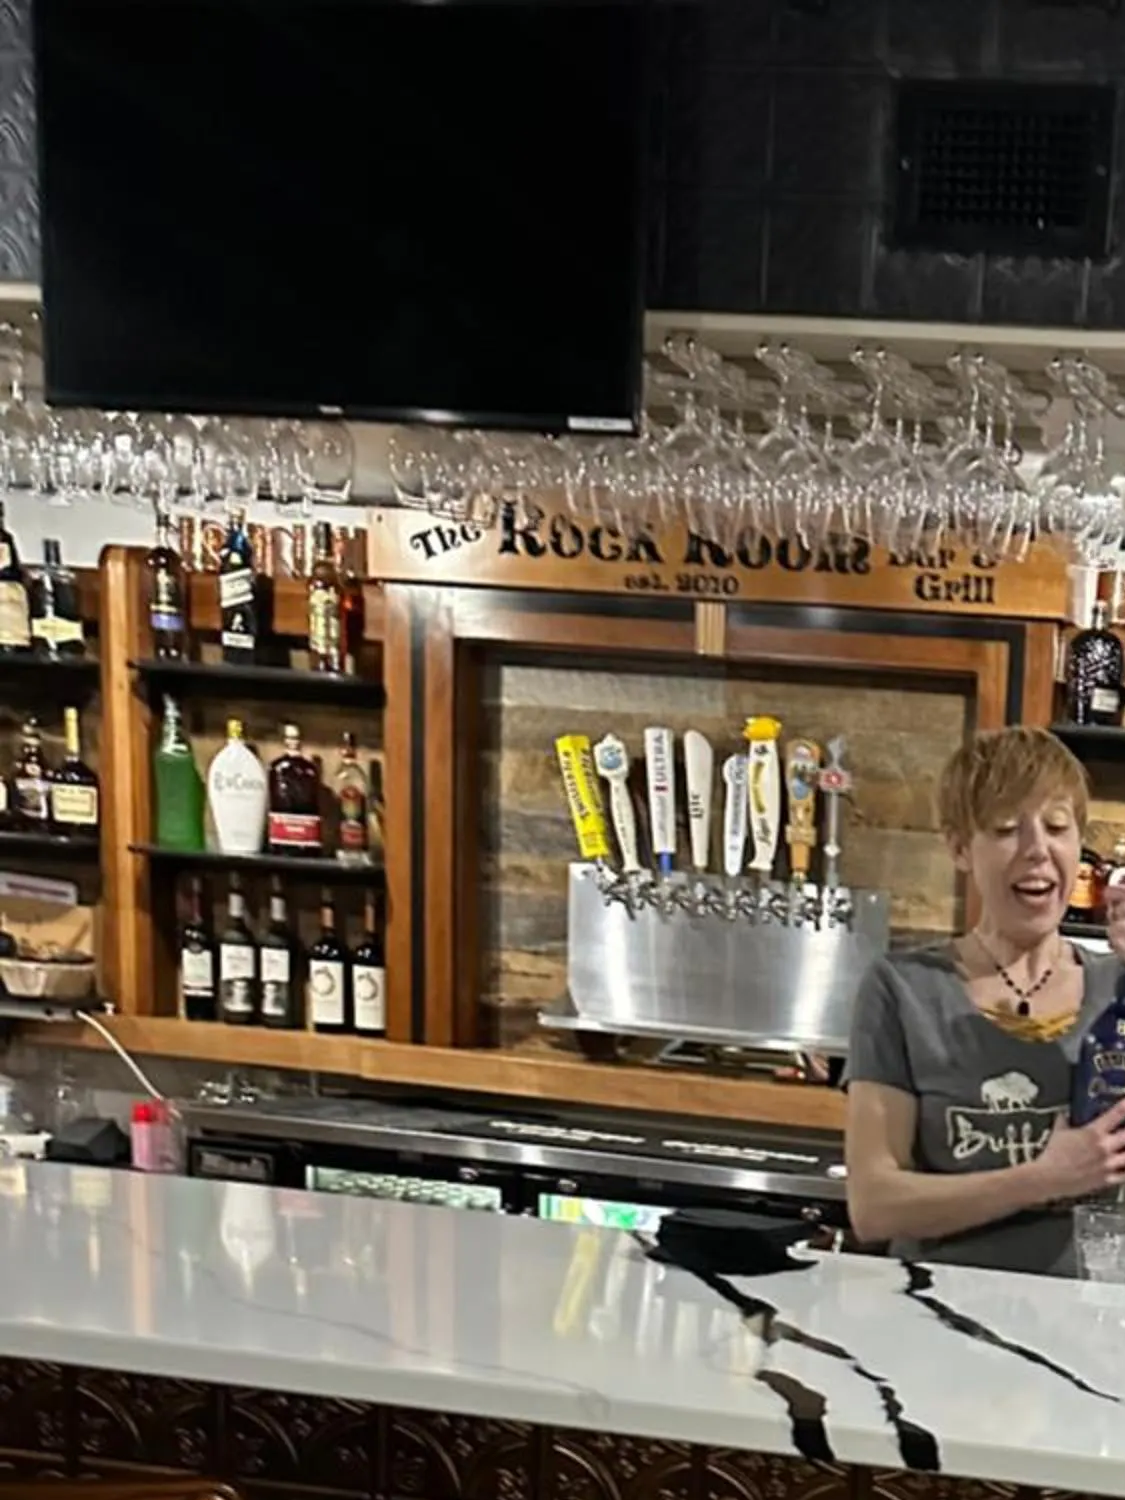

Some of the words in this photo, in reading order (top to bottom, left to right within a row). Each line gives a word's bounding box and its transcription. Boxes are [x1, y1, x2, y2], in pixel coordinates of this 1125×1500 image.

[410, 522, 481, 560] The
[915, 572, 995, 604] Grill
[653, 732, 667, 783] ULTRA
